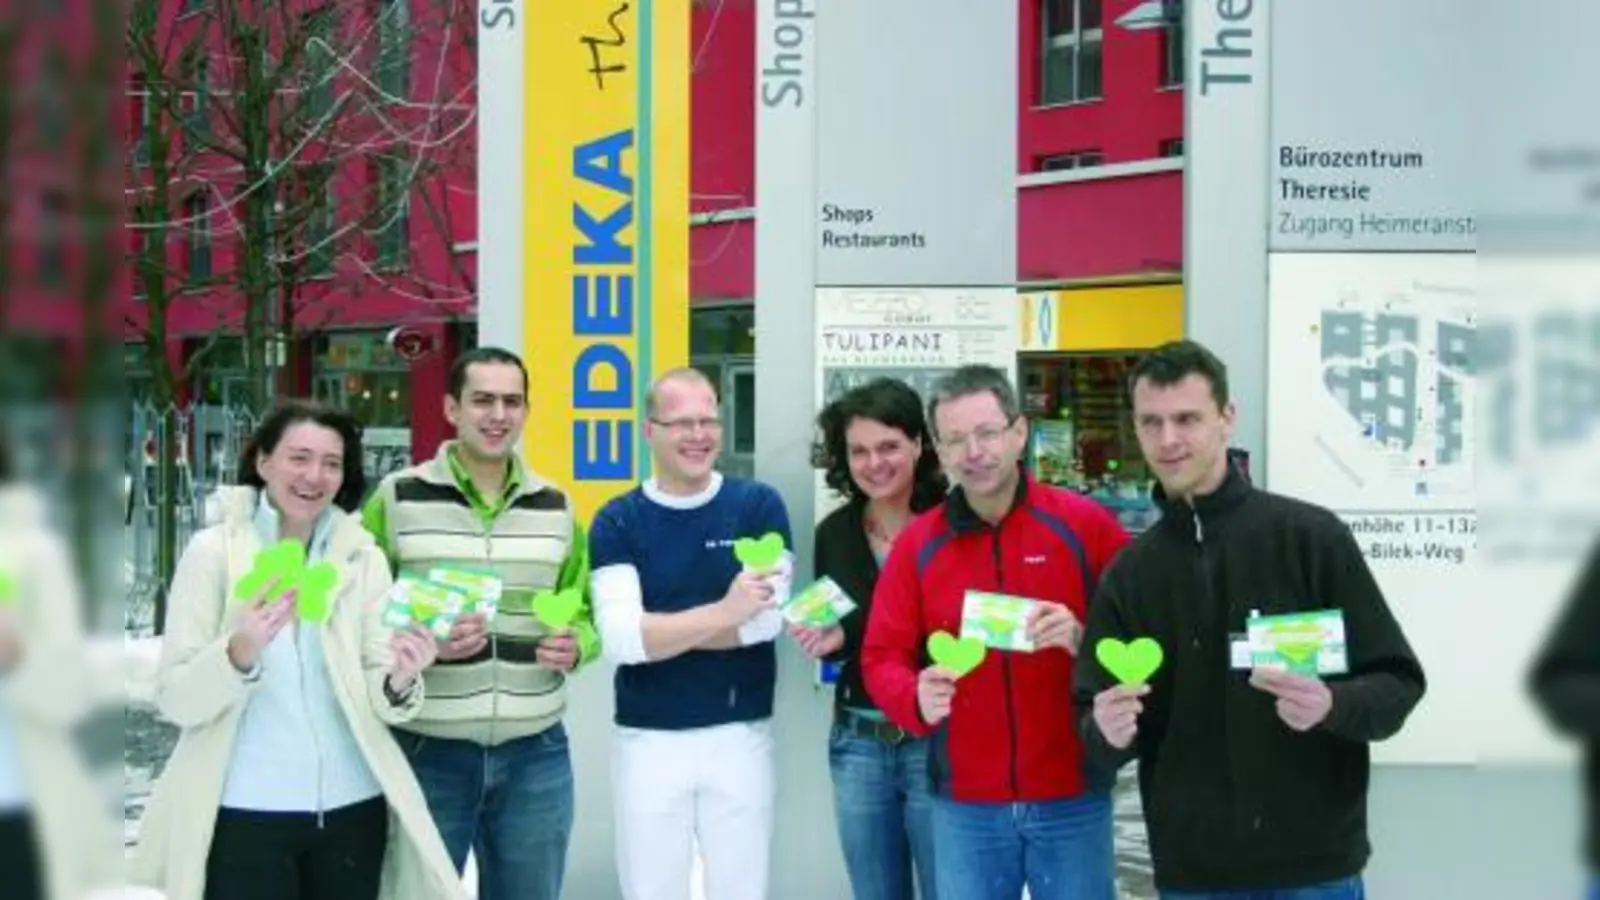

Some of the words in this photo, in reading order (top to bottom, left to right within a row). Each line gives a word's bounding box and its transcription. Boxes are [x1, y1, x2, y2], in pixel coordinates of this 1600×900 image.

[481, 0, 515, 30] S
[762, 0, 815, 109] Shop
[1200, 0, 1253, 96] The
[1280, 145, 1423, 168] Bürozentrum
[1280, 179, 1371, 201] Theresie
[822, 203, 874, 225] Shops
[1278, 212, 1354, 239] Zugang
[822, 229, 926, 249] Restaurants
[573, 129, 634, 480] EDEKA
[822, 332, 943, 351] TULIPANI
[1349, 516, 1405, 533] nhöhe
[1362, 541, 1466, 564] -Bilek-Weg
